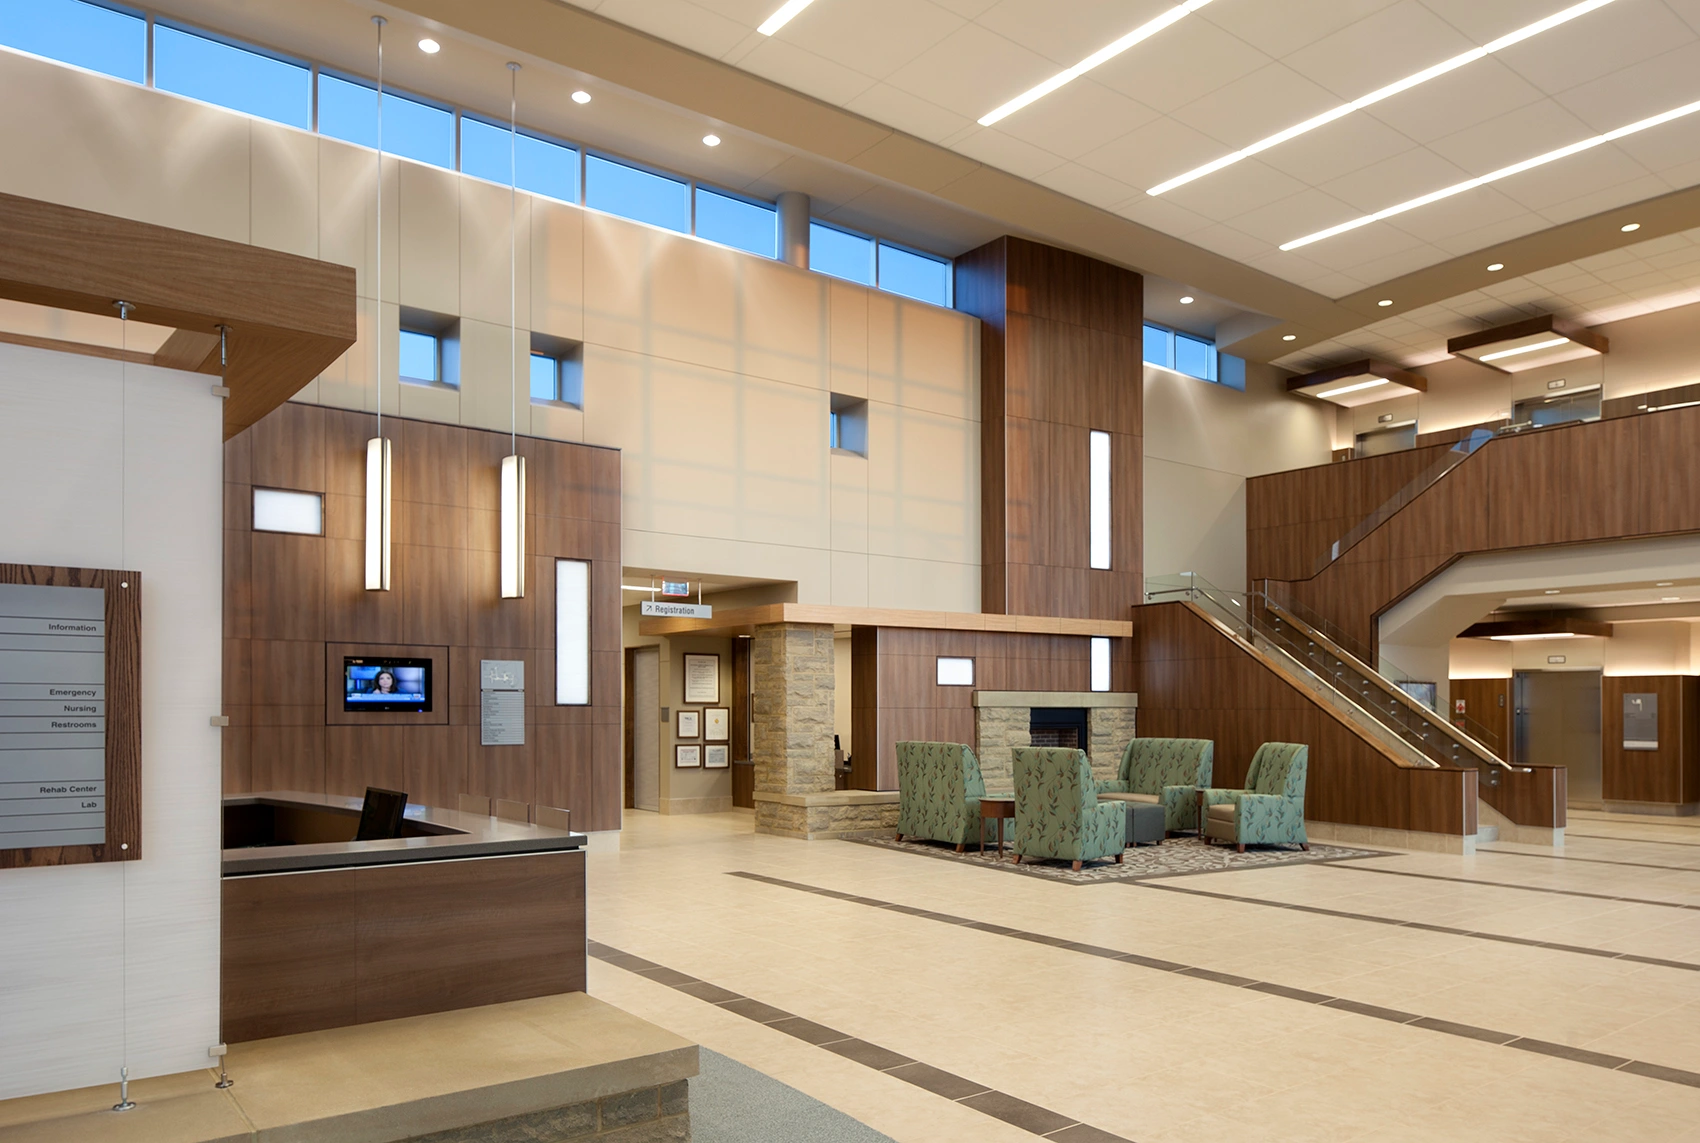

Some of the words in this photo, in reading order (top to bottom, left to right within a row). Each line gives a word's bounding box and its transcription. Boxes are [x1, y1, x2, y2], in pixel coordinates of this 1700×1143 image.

[655, 604, 695, 615] Registration
[48, 623, 97, 632] Information
[49, 689, 97, 697] Emergency
[63, 704, 97, 713] Nursing
[51, 721, 97, 729] Restrooms
[39, 786, 67, 794] Rehab
[69, 785, 97, 793] Center
[81, 801, 97, 809] Lab
